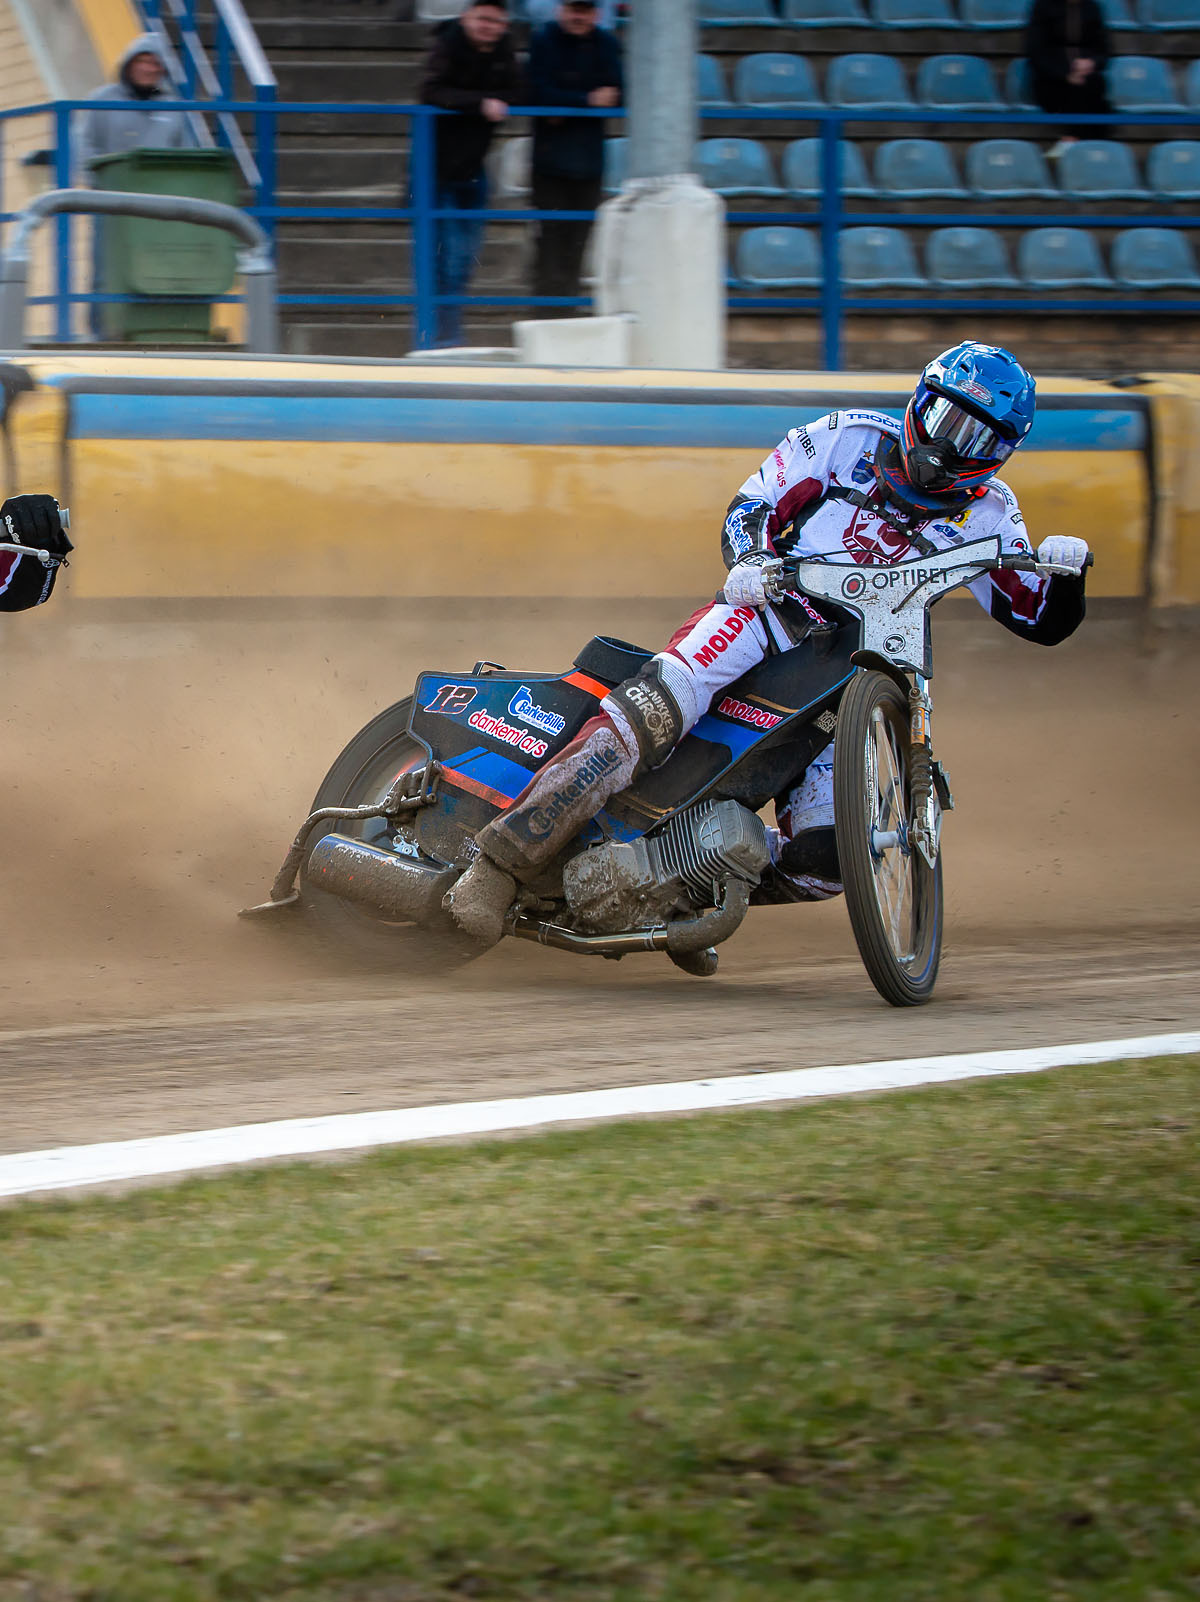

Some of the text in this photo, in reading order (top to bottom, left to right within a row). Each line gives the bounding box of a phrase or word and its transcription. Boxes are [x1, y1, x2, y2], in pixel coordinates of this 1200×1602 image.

[872, 568, 948, 589] OPTIBET
[424, 685, 478, 714] 12
[719, 697, 783, 728] MOLDOW
[518, 700, 565, 731] BarkerBille
[469, 709, 525, 745] dankemi
[521, 735, 547, 756] a/s
